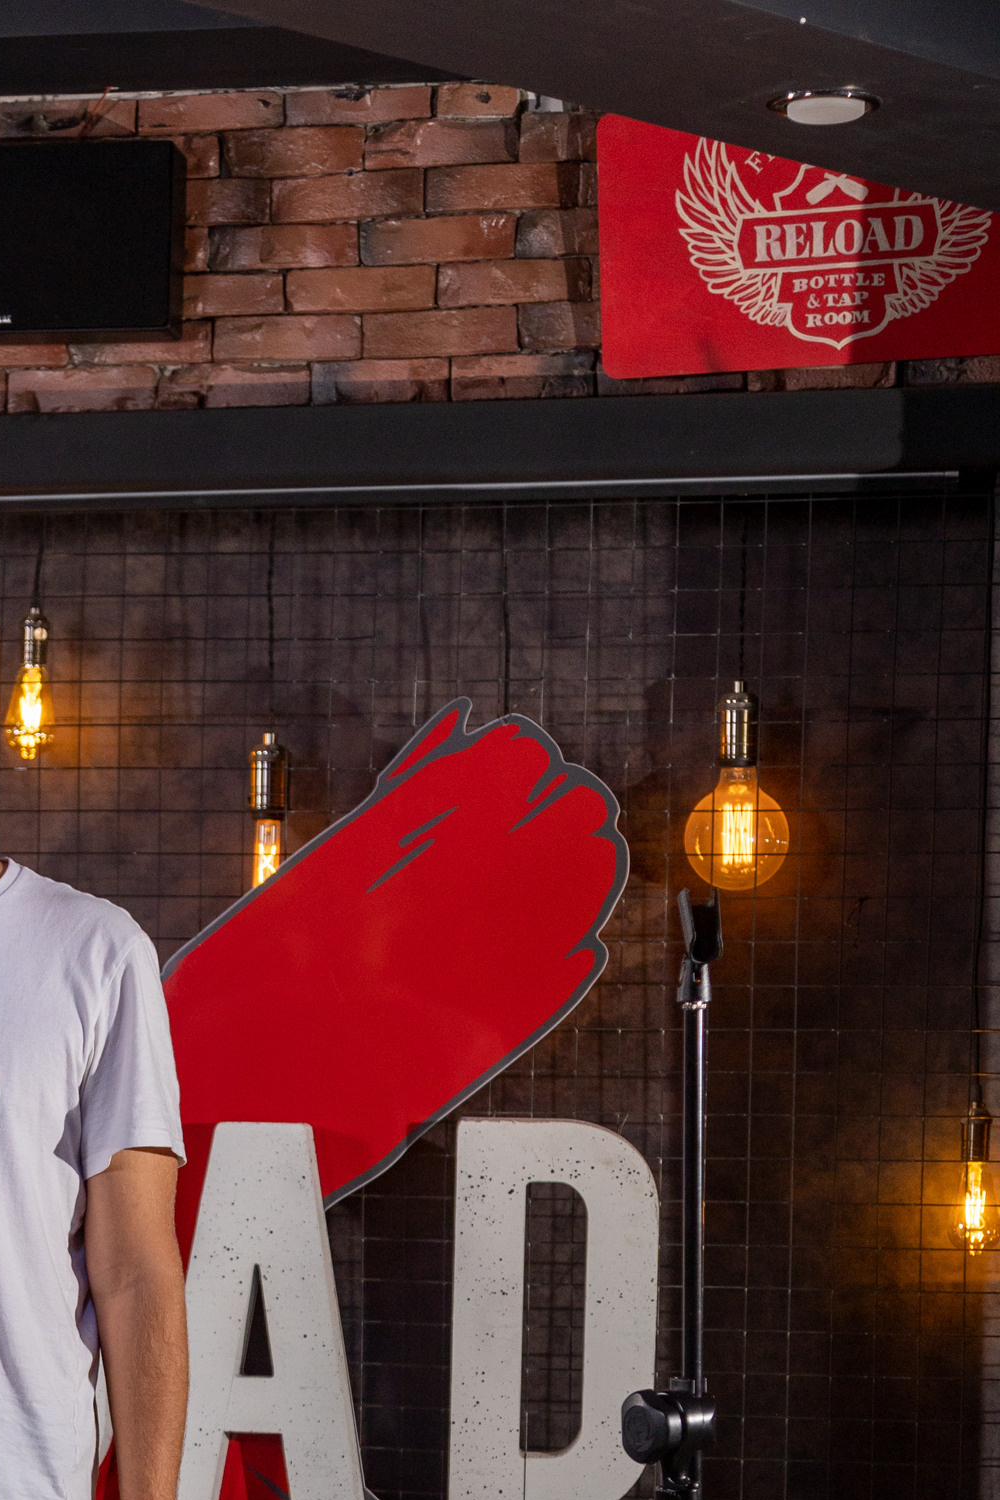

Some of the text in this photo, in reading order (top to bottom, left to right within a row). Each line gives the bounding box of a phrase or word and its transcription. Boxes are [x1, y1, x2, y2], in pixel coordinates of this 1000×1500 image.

[754, 215, 924, 262] RELOAD
[792, 273, 886, 293] BOTTLE
[806, 291, 869, 309] & TAP
[805, 310, 870, 328] ROOM
